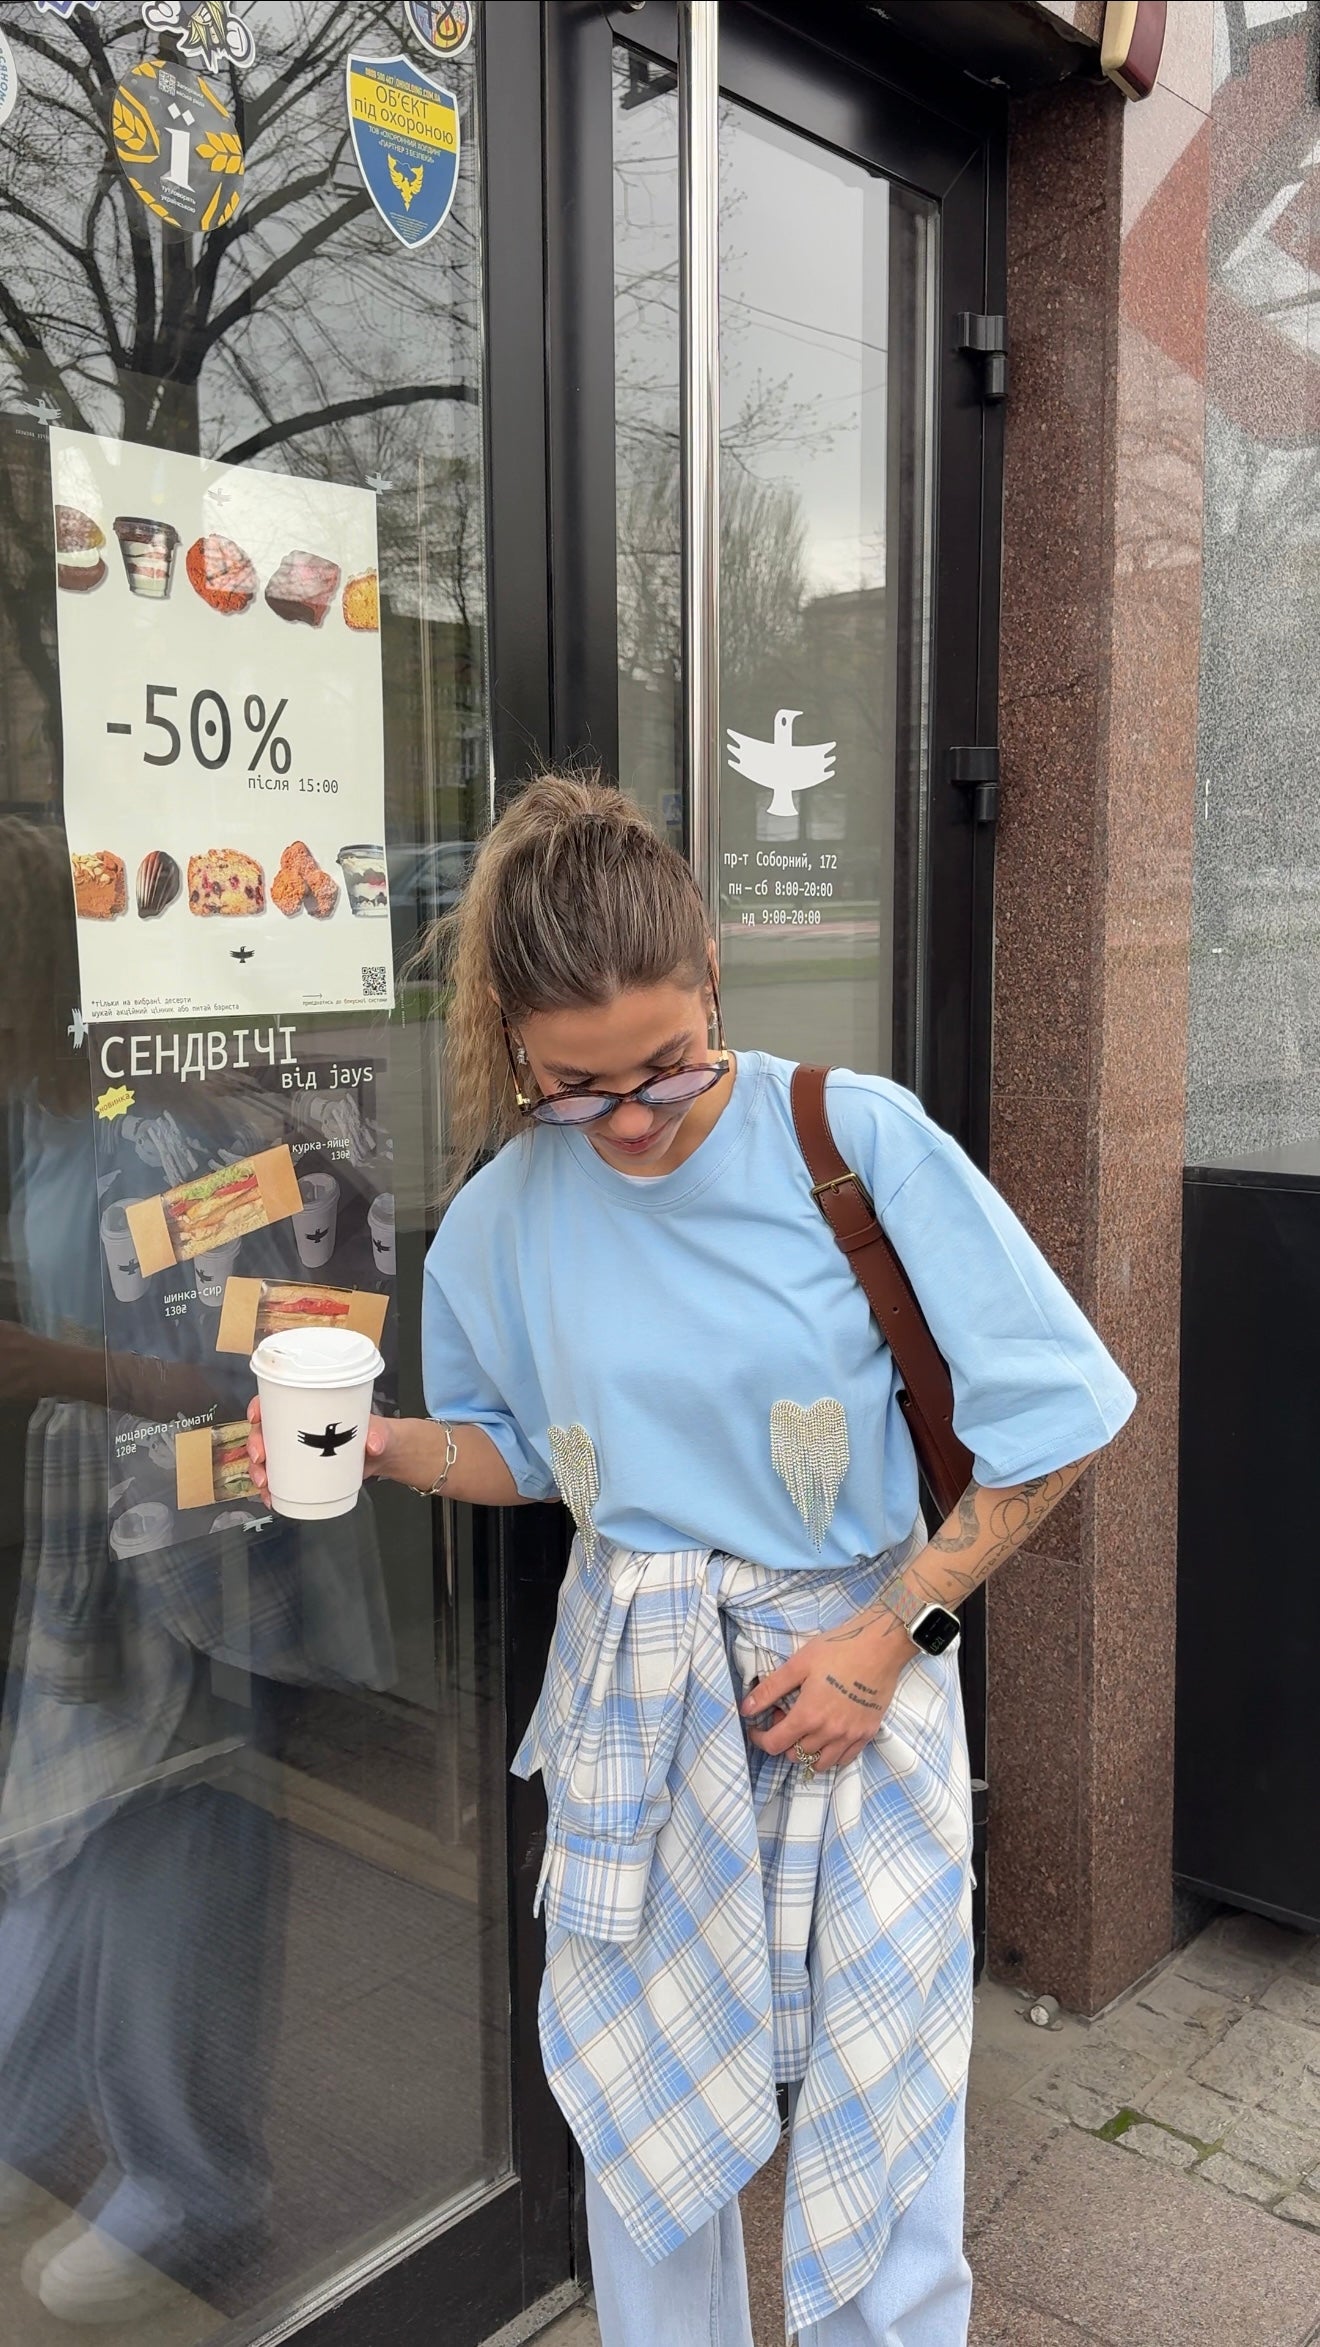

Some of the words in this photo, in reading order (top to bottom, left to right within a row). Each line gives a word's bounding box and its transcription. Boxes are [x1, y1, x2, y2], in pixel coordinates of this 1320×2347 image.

[354, 97, 376, 121] під
[380, 108, 453, 145] охороною
[107, 684, 292, 775] -50%
[248, 774, 289, 791] після
[299, 778, 339, 794] 15:00
[723, 853, 749, 868] пр-т
[756, 851, 812, 870] Соборний,
[820, 854, 837, 869] 172
[741, 912, 755, 927] нд
[91, 1009, 113, 1018] шукай
[177, 1005, 190, 1013] або
[192, 1004, 211, 1012] питай
[213, 1003, 240, 1012] бариста
[134, 996, 161, 1007] вибрані
[164, 997, 192, 1005] десерти
[100, 1026, 298, 1083] СЕНДВІЧІ
[281, 1067, 317, 1090] від
[329, 1063, 373, 1089] jays
[99, 1093, 130, 1113] новинка
[292, 1137, 350, 1155] курка-яйце
[163, 1285, 222, 1304] шинка-сир
[114, 1412, 213, 1445] моцарела-томати
